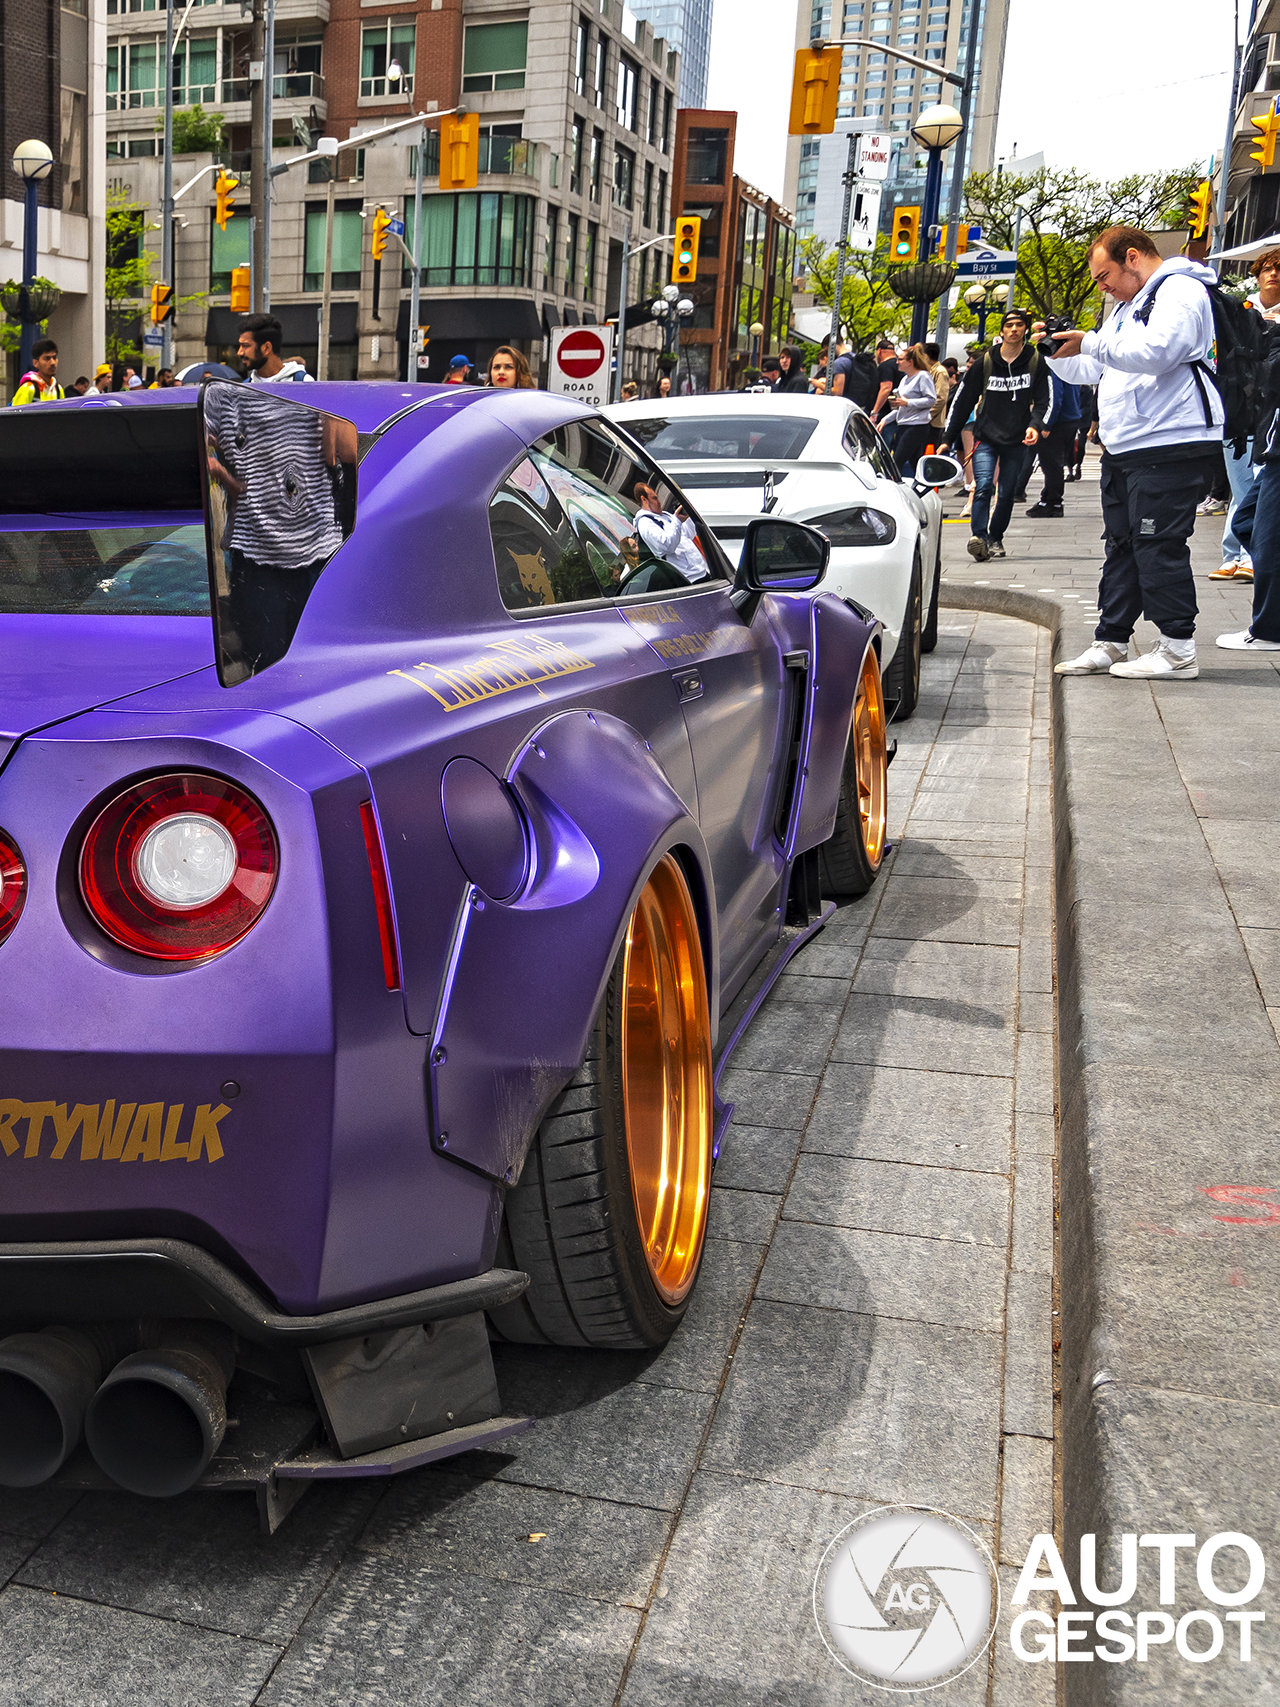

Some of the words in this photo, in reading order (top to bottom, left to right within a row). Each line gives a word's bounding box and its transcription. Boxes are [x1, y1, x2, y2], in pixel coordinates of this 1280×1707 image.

[871, 136, 880, 147] NO
[861, 151, 888, 163] STANDING
[972, 263, 989, 274] Bay
[989, 263, 997, 272] St
[563, 383, 594, 391] ROAD
[387, 655, 548, 712] Liberty
[485, 634, 596, 677] Walk
